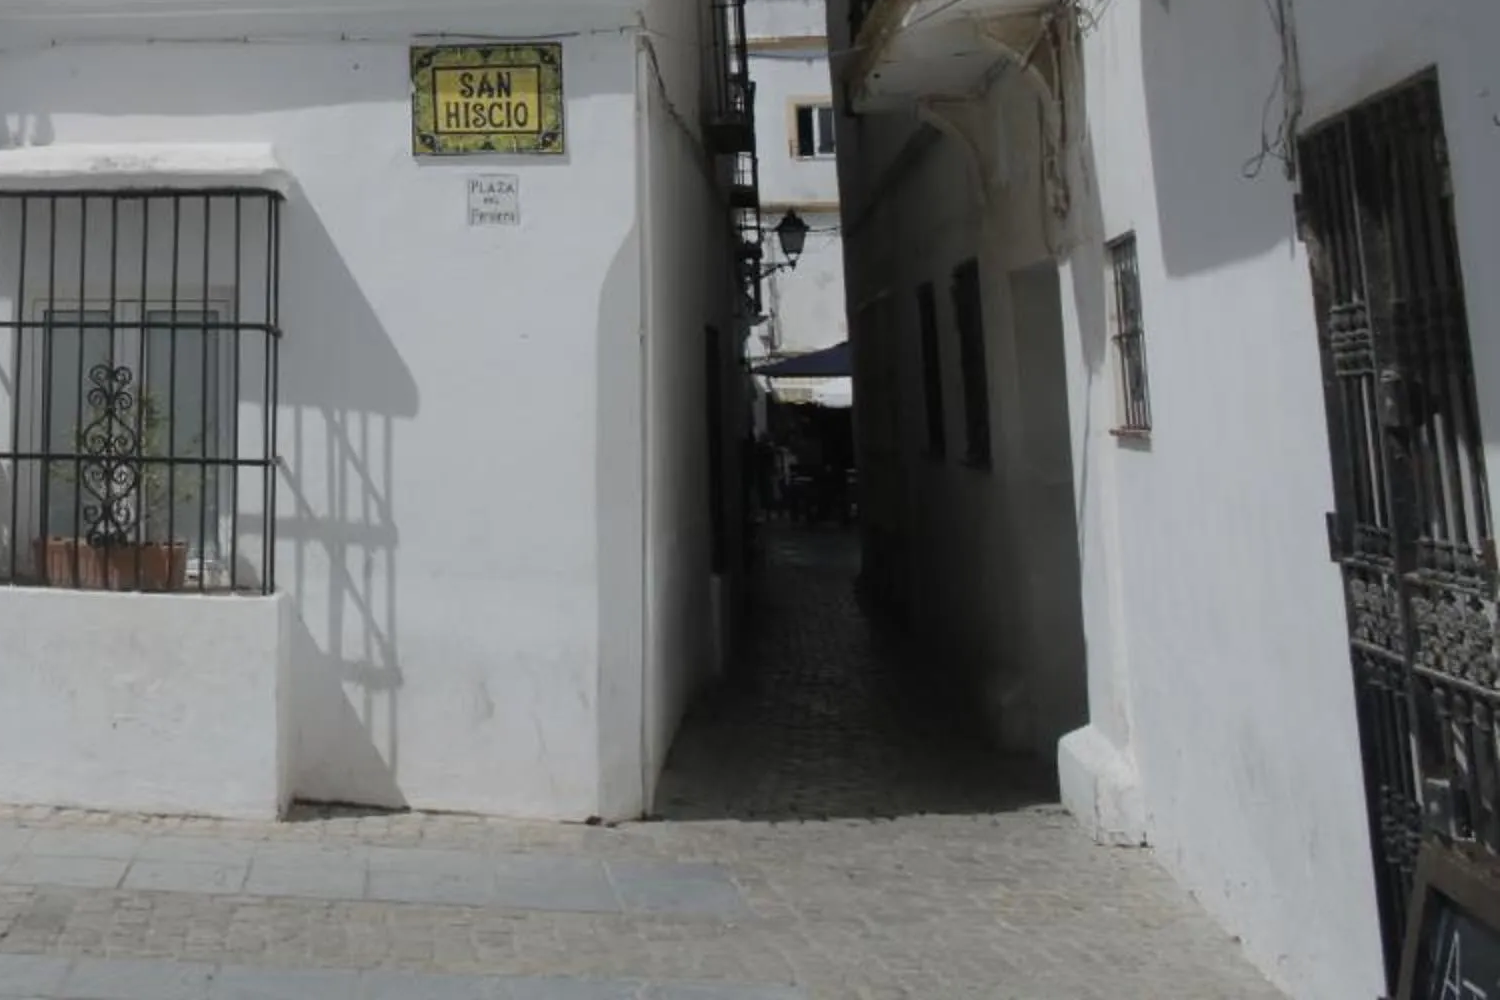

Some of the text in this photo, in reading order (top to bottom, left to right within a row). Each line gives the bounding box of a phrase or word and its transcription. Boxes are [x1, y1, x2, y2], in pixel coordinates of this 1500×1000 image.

[459, 71, 512, 98] SAN
[446, 102, 528, 129] HISCIO
[470, 179, 516, 194] PLAZA
